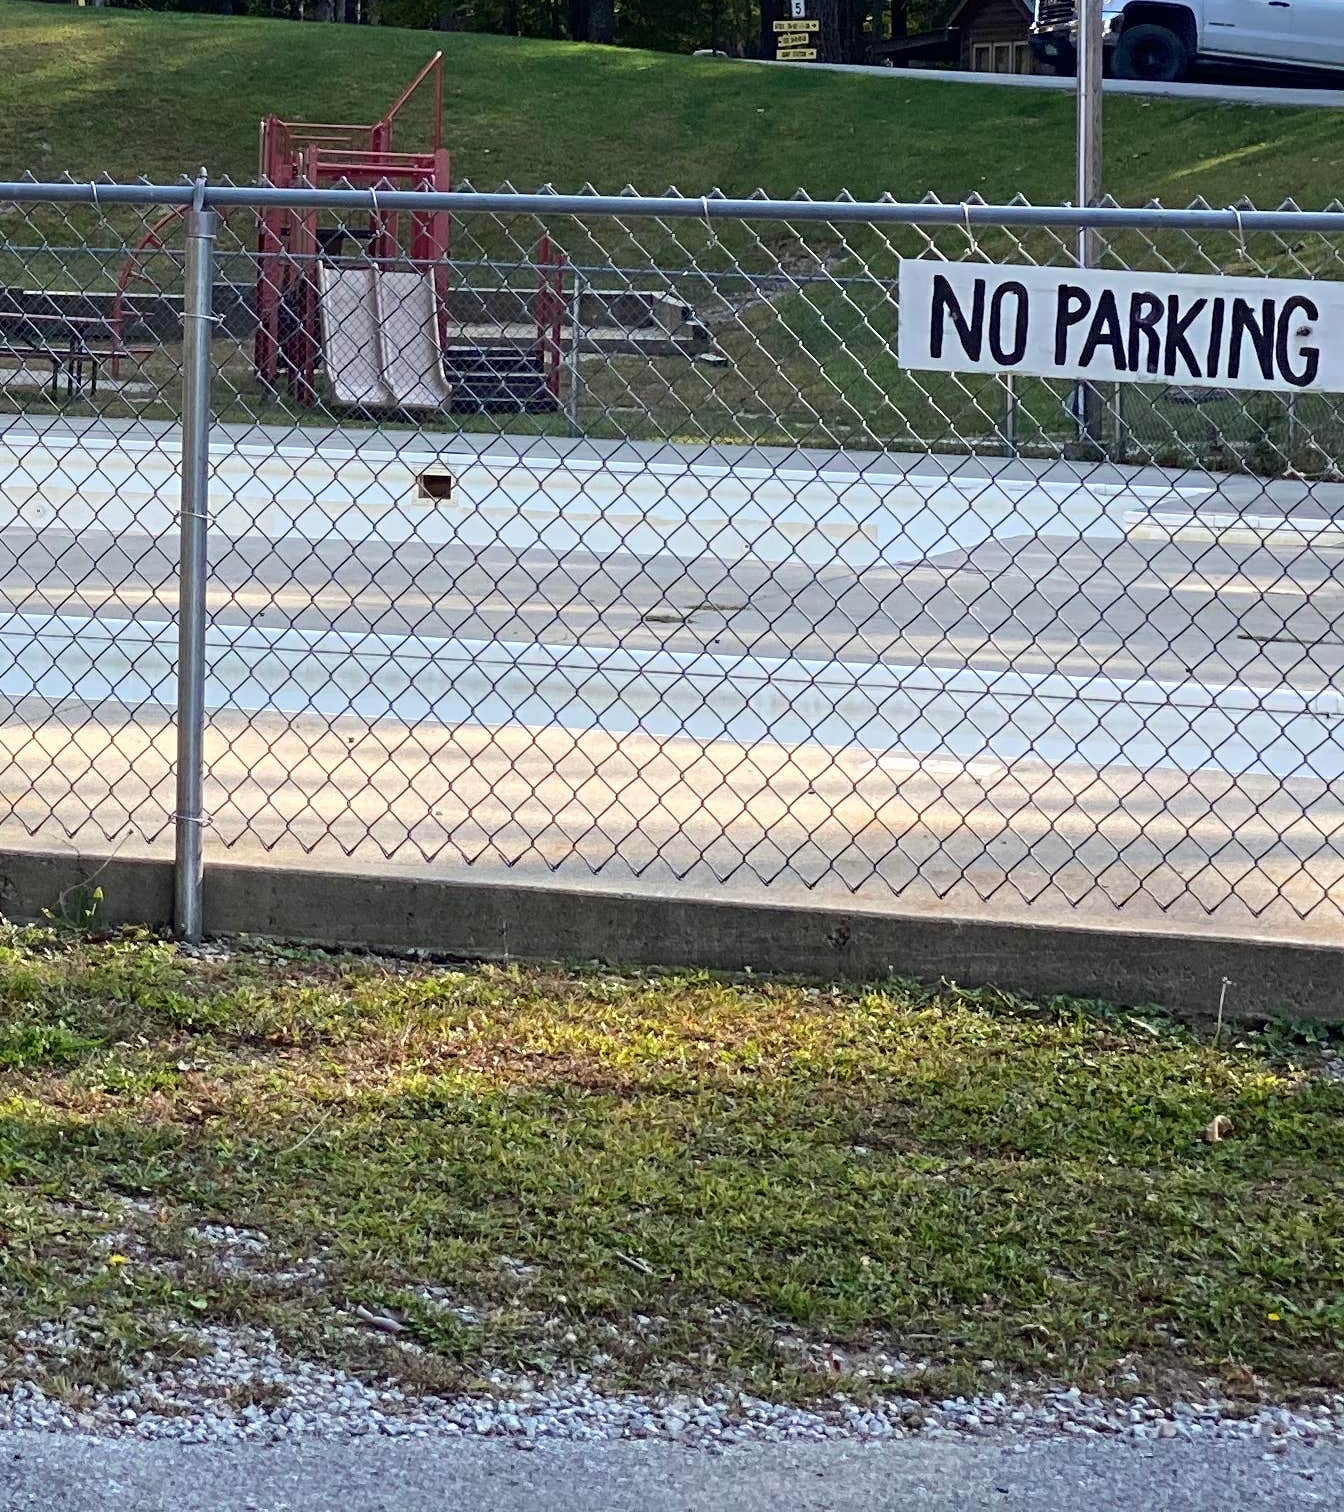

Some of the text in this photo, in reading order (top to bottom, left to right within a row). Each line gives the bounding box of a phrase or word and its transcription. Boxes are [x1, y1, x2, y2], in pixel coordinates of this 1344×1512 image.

[795, 2, 802, 15] 5
[930, 274, 1320, 387] NO PARKING
